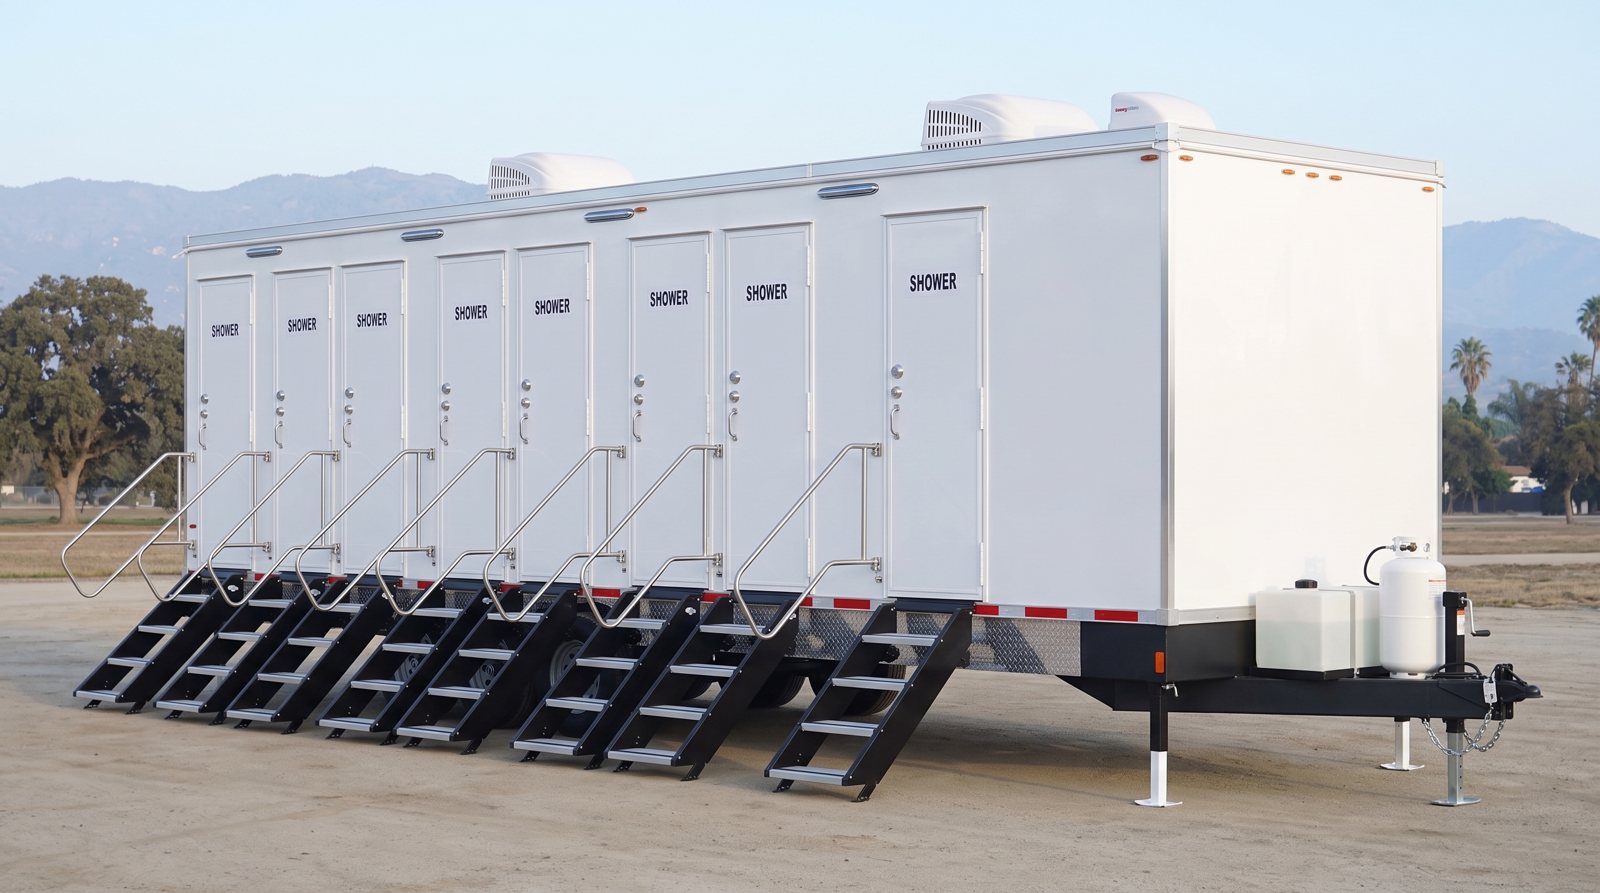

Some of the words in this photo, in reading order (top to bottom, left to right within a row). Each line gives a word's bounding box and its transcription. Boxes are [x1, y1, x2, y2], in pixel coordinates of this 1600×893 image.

[910, 273, 956, 292] SHOWER
[650, 290, 688, 307] SHOWER
[746, 284, 787, 301] SHOWER
[455, 305, 488, 320] SHOWER
[535, 299, 570, 315] SHOWER
[288, 318, 316, 332] SHOWER
[357, 313, 387, 327] SHOWER
[212, 324, 239, 337] SHOWER
